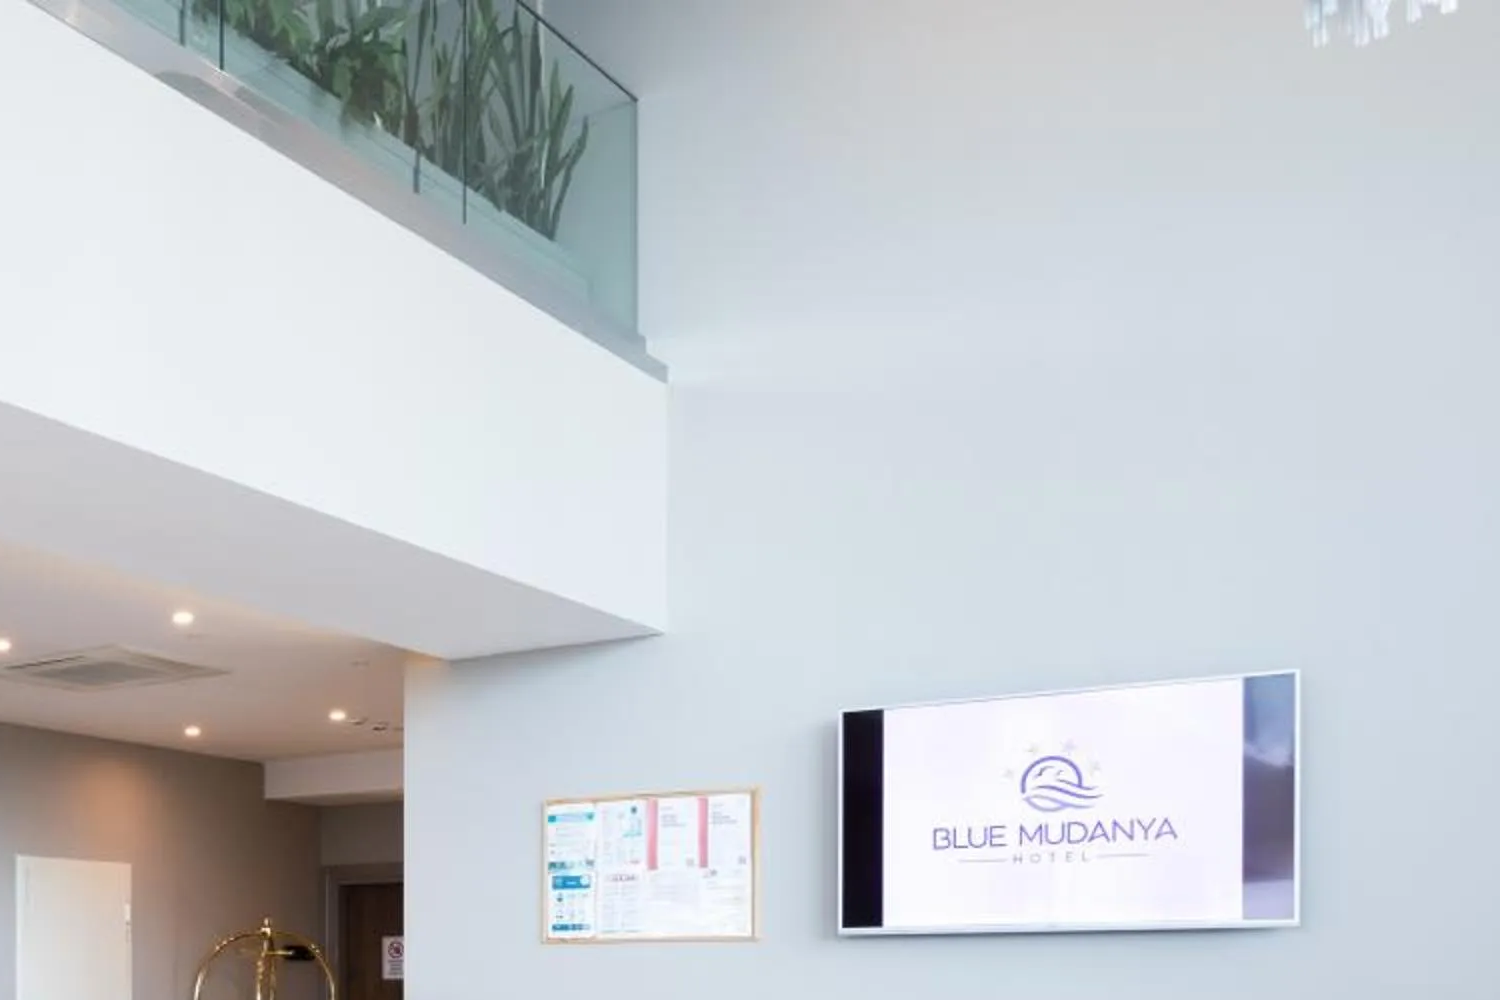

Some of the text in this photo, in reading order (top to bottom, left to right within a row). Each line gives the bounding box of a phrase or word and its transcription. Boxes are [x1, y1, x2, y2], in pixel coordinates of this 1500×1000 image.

[932, 817, 1179, 852] BLUE MUDANYA
[1013, 850, 1090, 865] HOTEL
